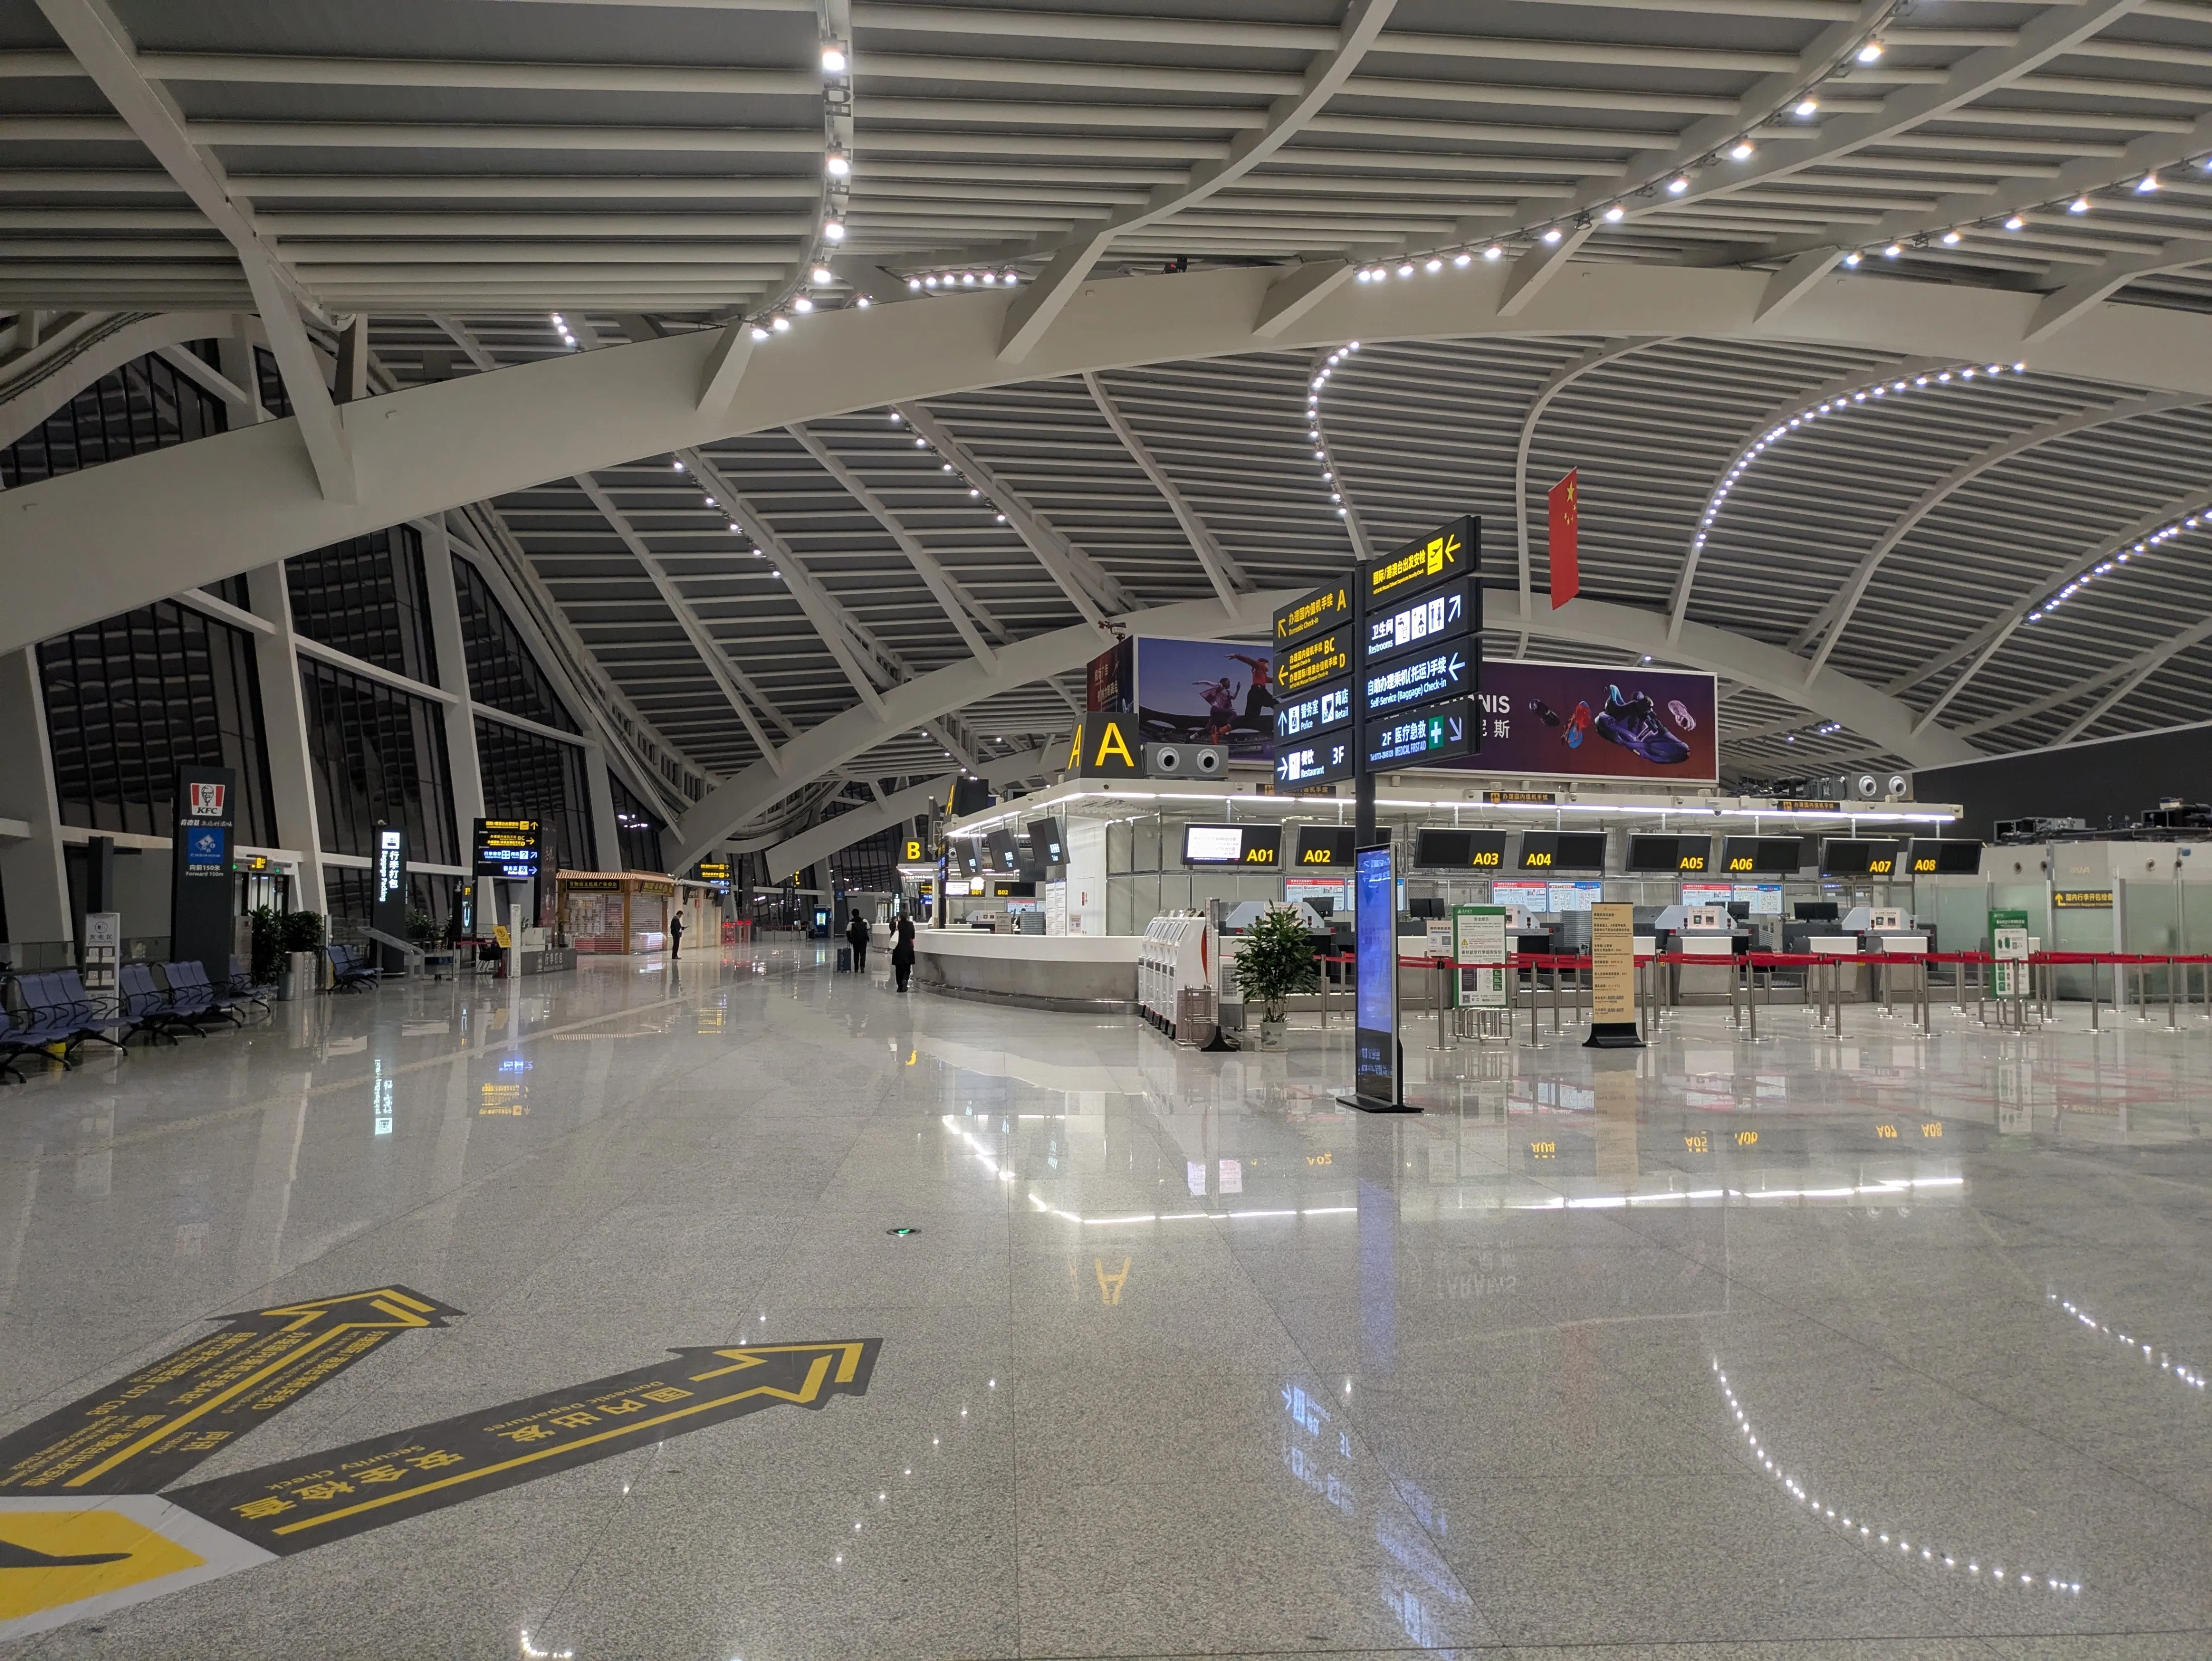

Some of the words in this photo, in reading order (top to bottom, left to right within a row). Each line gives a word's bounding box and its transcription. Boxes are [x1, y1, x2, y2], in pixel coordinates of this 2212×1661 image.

[1373, 549, 1426, 586] 国际/港澳台出发安检
[1288, 593, 1334, 626] 办理国内值机手续
[1337, 589, 1347, 611] A
[1288, 624, 1303, 636] Domestic
[1303, 617, 1319, 629] Check-in
[1371, 618, 1394, 640] 卫生间
[1289, 642, 1323, 664] 办理国内值机手续
[1324, 637, 1335, 655] BC
[1368, 639, 1393, 655] Restrooms
[1289, 655, 1338, 683] 办理国际/港澳台值机手续
[1339, 653, 1345, 668] D
[1368, 656, 1446, 696] 自助办理乘机(托运)手续
[1335, 688, 1348, 707] 商店
[1370, 693, 1397, 708] Self-Service
[1398, 684, 1423, 702] (Baggage)
[1424, 677, 1446, 693] Check-in
[1301, 699, 1319, 719] 警务室
[1335, 706, 1349, 720] Retail
[1301, 719, 1313, 730] Police
[1395, 720, 1426, 743] 医疗急救
[1068, 724, 1082, 770] A
[1095, 722, 1134, 767] A
[1382, 731, 1392, 746] 2F
[1301, 749, 1314, 766] 餐饮
[1333, 745, 1344, 765] 3F
[1395, 743, 1411, 756] MEDICAL
[1410, 741, 1420, 753] FIRST
[1301, 766, 1325, 778] Restaurant
[1502, 793, 1548, 801] 办理国内值机手续
[907, 842, 920, 859] B
[1247, 849, 1273, 862] A01
[1303, 850, 1330, 863] A02
[1473, 853, 1498, 865] A03
[1527, 853, 1551, 866] A04
[380, 850, 388, 877] Baggage
[389, 851, 399, 888] 行李打包
[1680, 857, 1703, 870] A05
[1730, 858, 1753, 870] A06
[1870, 861, 1891, 873] A07
[1914, 859, 1935, 871] A08
[379, 878, 387, 902] Packing
[120, 1385, 156, 1399] C07
[590, 1381, 663, 1409] Domestic
[86, 1400, 127, 1415] C08
[498, 1386, 695, 1443] 国内出发
[483, 1403, 586, 1433] Departures
[151, 1432, 197, 1455] Enquiry
[180, 1431, 234, 1450] 问讯
[341, 1445, 426, 1471] Security
[231, 1449, 465, 1520] 安全检查
[265, 1469, 337, 1491] Check
